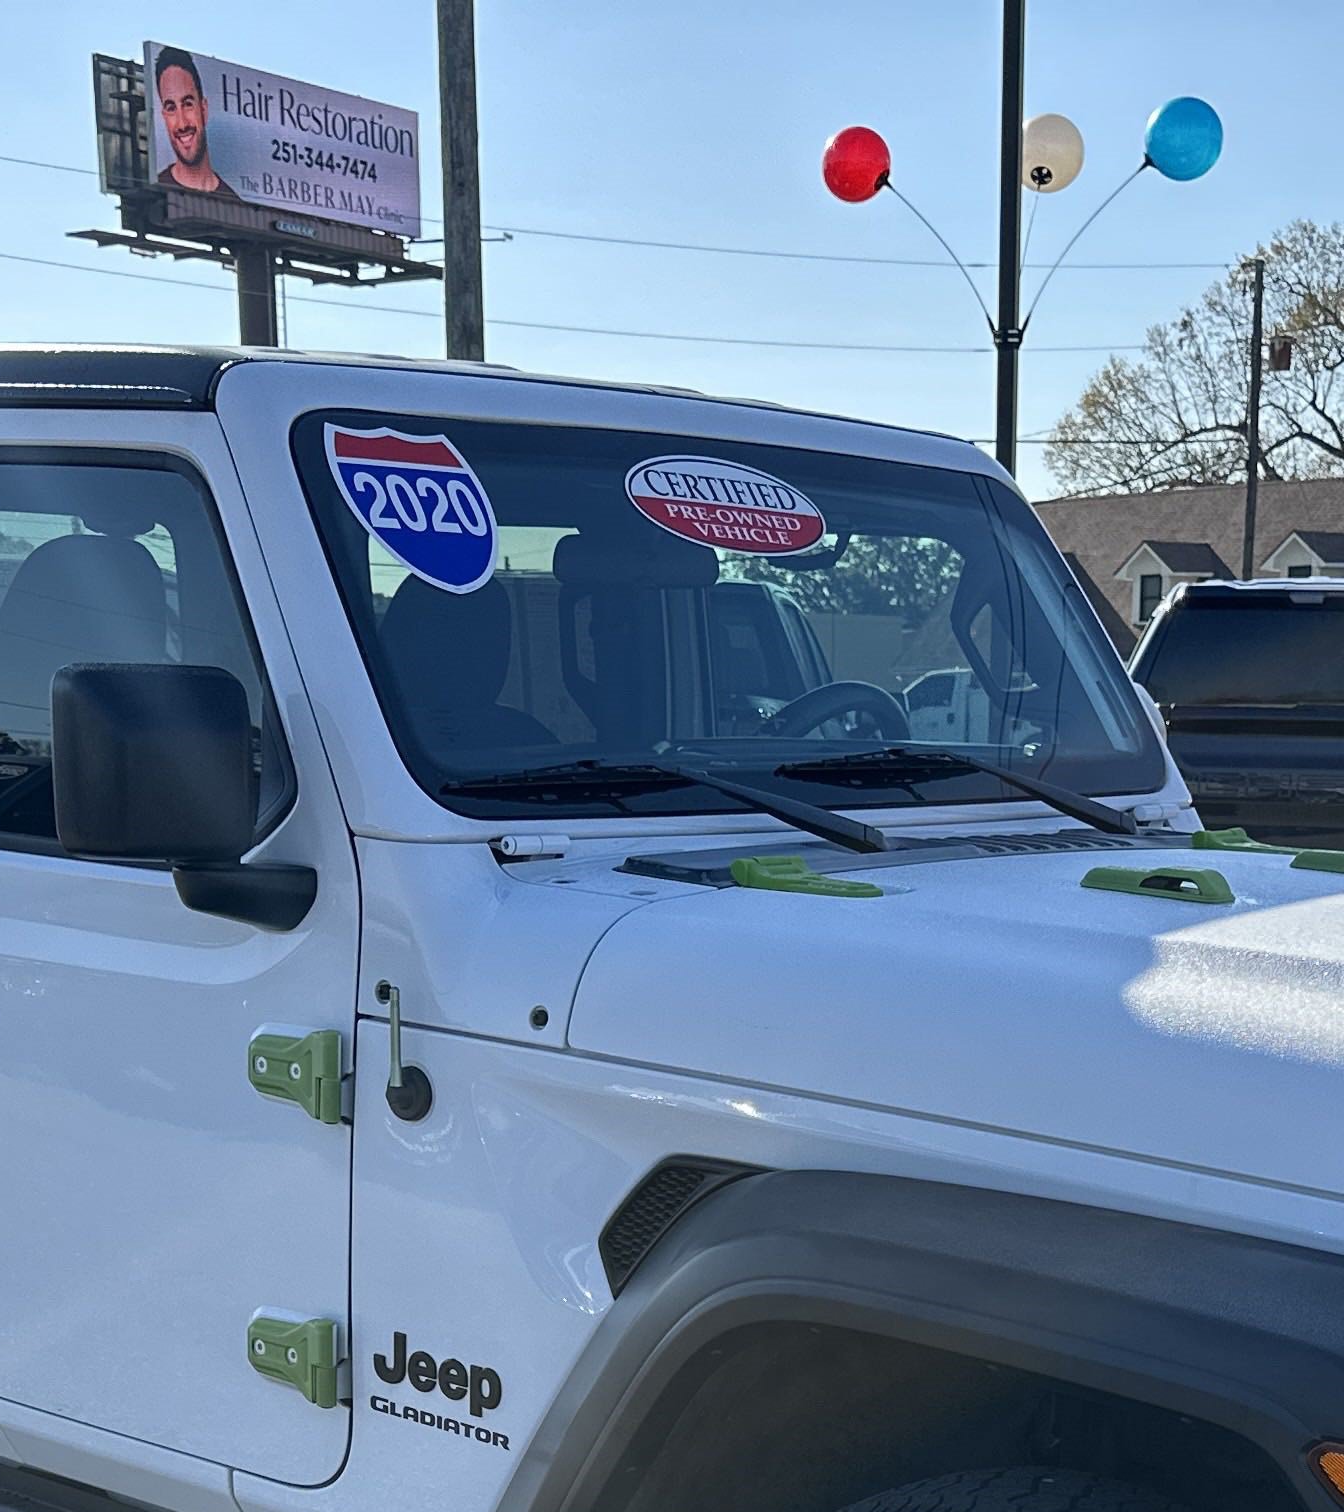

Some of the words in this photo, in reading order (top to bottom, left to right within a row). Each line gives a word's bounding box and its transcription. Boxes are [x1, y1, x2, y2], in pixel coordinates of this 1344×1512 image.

[222, 74, 273, 122] Hair
[279, 88, 414, 158] Restoration
[272, 139, 378, 183] 251-344-7474
[240, 175, 259, 193] The
[262, 172, 336, 209] BARBER
[339, 190, 376, 217] MAY
[354, 472, 487, 536] 2020
[643, 469, 797, 511] CERTIFIED
[664, 503, 801, 532] PRE-OWNED
[693, 522, 793, 546] VEHICLE
[373, 1331, 502, 1417] Jeep
[370, 1395, 510, 1450] GLADIATOR
